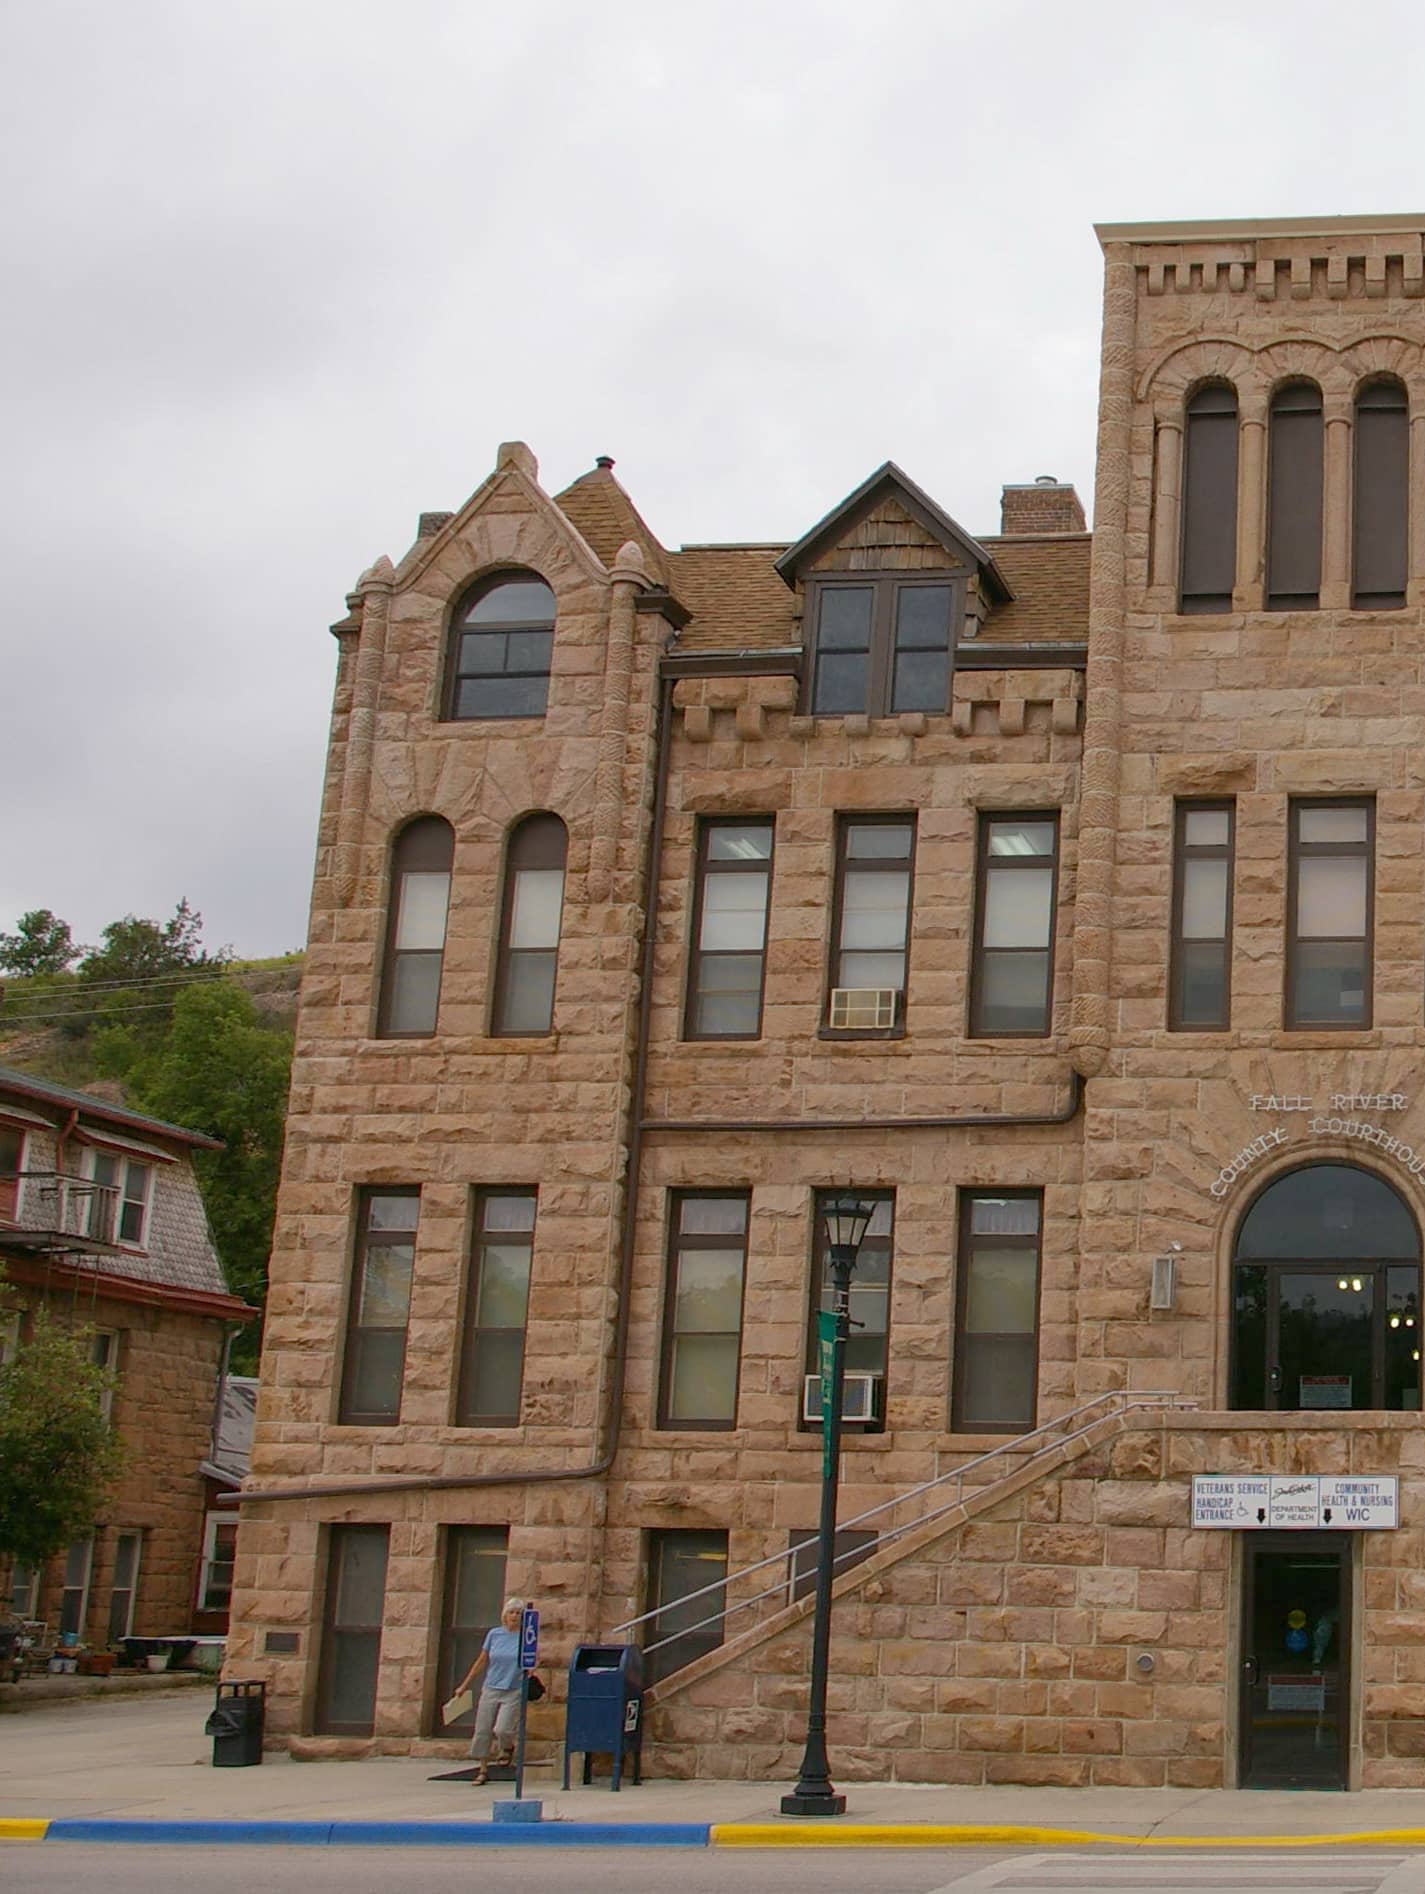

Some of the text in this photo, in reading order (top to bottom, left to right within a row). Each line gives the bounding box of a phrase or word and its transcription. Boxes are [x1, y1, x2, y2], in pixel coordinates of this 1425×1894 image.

[1251, 1093, 1405, 1111] FALL RIVER
[1210, 1127, 1285, 1197] COUNTY
[1196, 1483, 1233, 1494] VETERANS
[1237, 1483, 1268, 1494] SERVICE
[1335, 1483, 1380, 1494] COMMUNITY
[1196, 1497, 1233, 1508] HANDICAP
[1321, 1495, 1348, 1507] HEALTH
[1360, 1496, 1394, 1507] NURSING
[1196, 1509, 1233, 1520] ENTRANCE
[1272, 1505, 1317, 1513] DEPARTMENT
[1346, 1507, 1371, 1521] WIC
[1275, 1513, 1315, 1521] OF HEALTH
